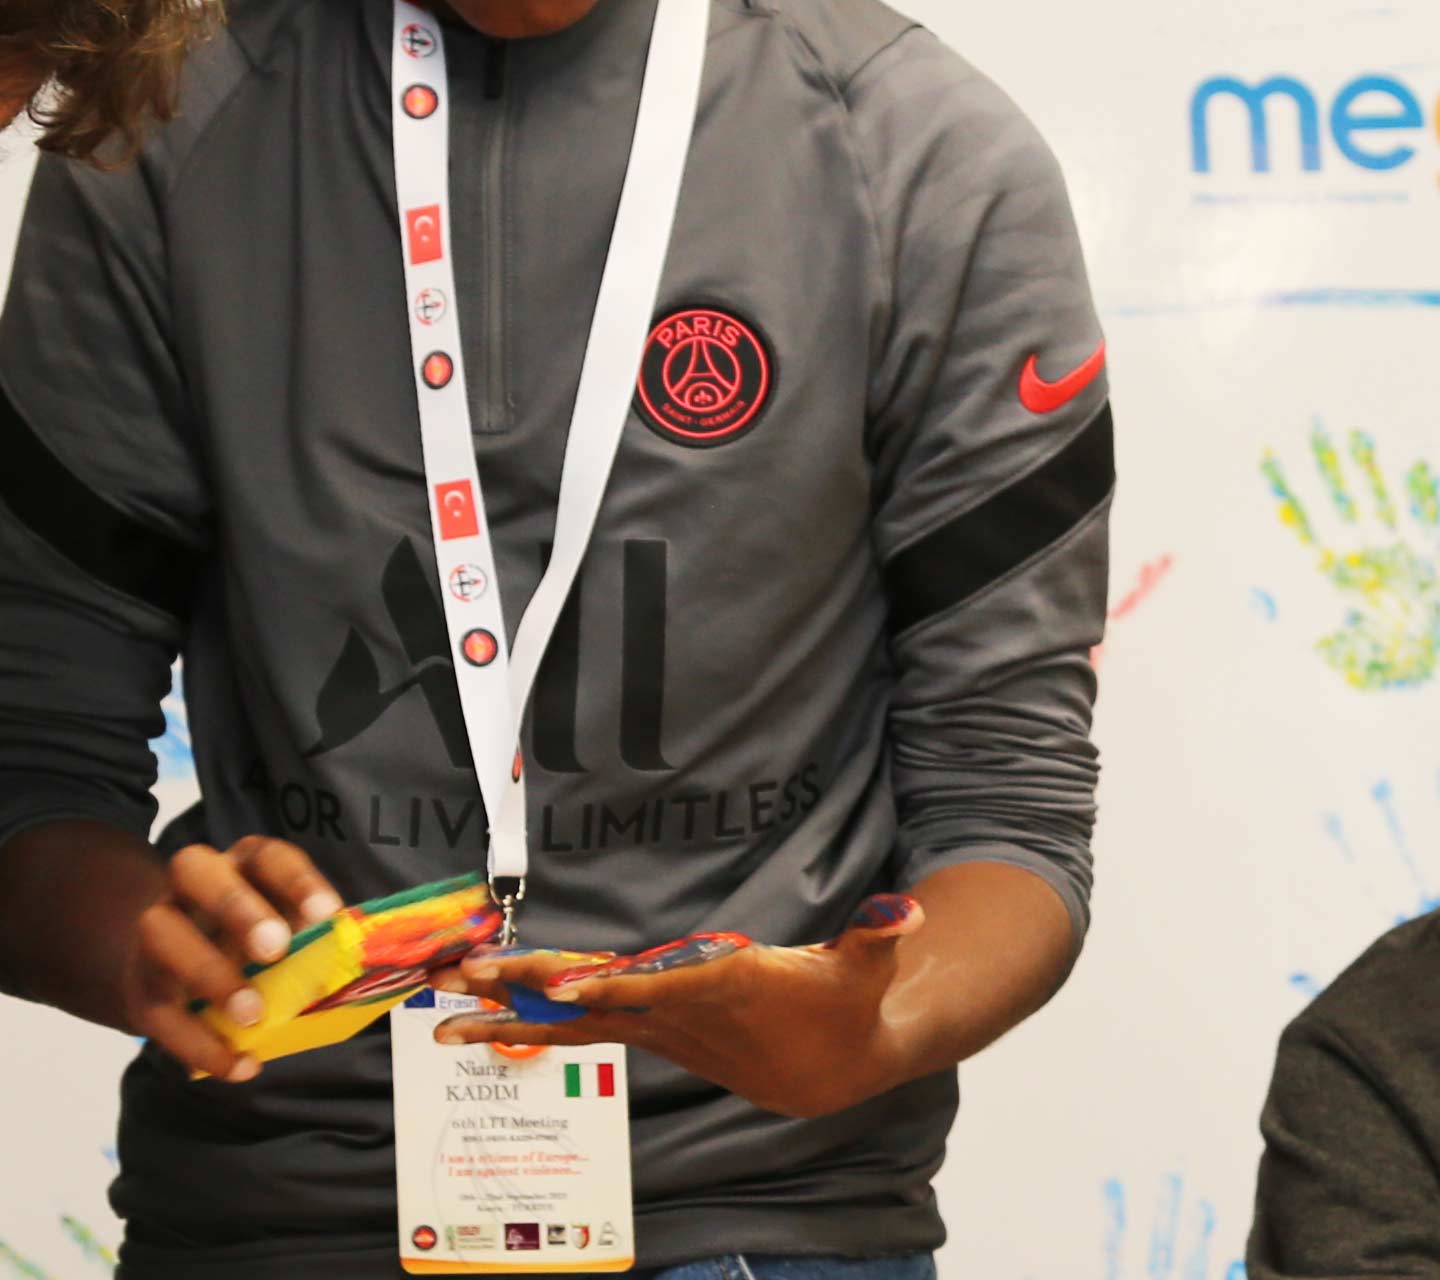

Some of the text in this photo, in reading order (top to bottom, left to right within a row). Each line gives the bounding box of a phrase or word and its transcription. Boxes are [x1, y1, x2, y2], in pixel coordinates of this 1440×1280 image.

[656, 317, 740, 348] PARIS
[368, 794, 477, 848] LIV
[542, 762, 820, 854] LIMITLESS
[455, 1061, 508, 1077] Niang
[446, 1085, 520, 1102] KADIM
[512, 1116, 568, 1131] Meeting
